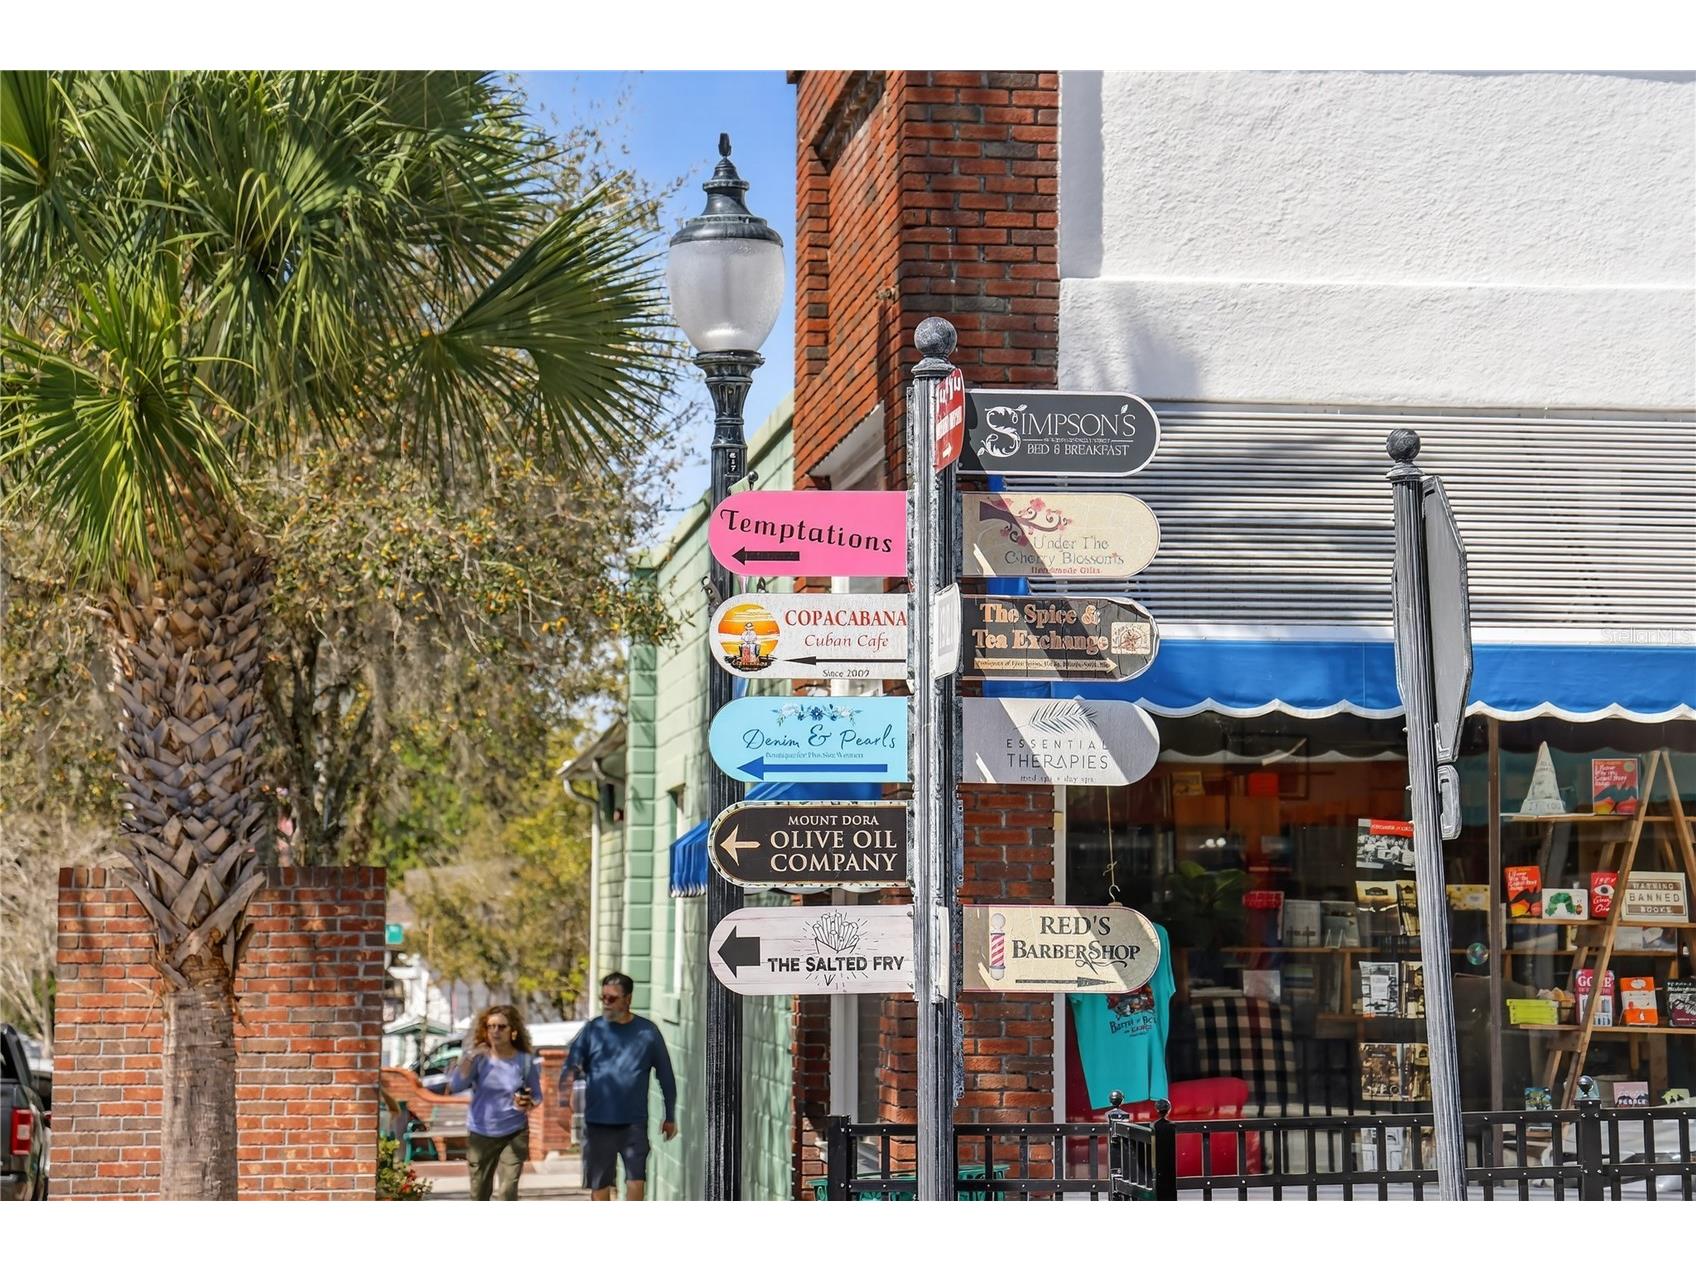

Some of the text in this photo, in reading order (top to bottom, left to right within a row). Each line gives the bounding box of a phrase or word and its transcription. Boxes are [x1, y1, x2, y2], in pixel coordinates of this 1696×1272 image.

[1027, 443, 1049, 455] BED
[1064, 444, 1130, 457] BREAKFAST
[719, 508, 893, 553] Temptations
[1033, 535, 1110, 553] Under The
[1004, 550, 1125, 566] Cherry Blossoms
[784, 609, 907, 627] COPACABANA
[979, 603, 1100, 629] The Spice &
[804, 631, 889, 653] Cuban Cafe
[971, 628, 1009, 650] Tea
[1011, 629, 1109, 656] Exchange
[822, 669, 844, 678] Since
[742, 723, 896, 750] Denim & Pearls
[1006, 738, 1109, 751] ESSENTIAL
[1006, 753, 1109, 770] THERAPIES
[788, 815, 880, 826] MOUNT DORA
[770, 830, 897, 849] OLIVE OIL
[770, 853, 898, 872] COMPANY
[1629, 892, 1680, 902] BANNED
[1039, 915, 1111, 936] RED'S
[767, 956, 905, 972] THE SALTED FRY
